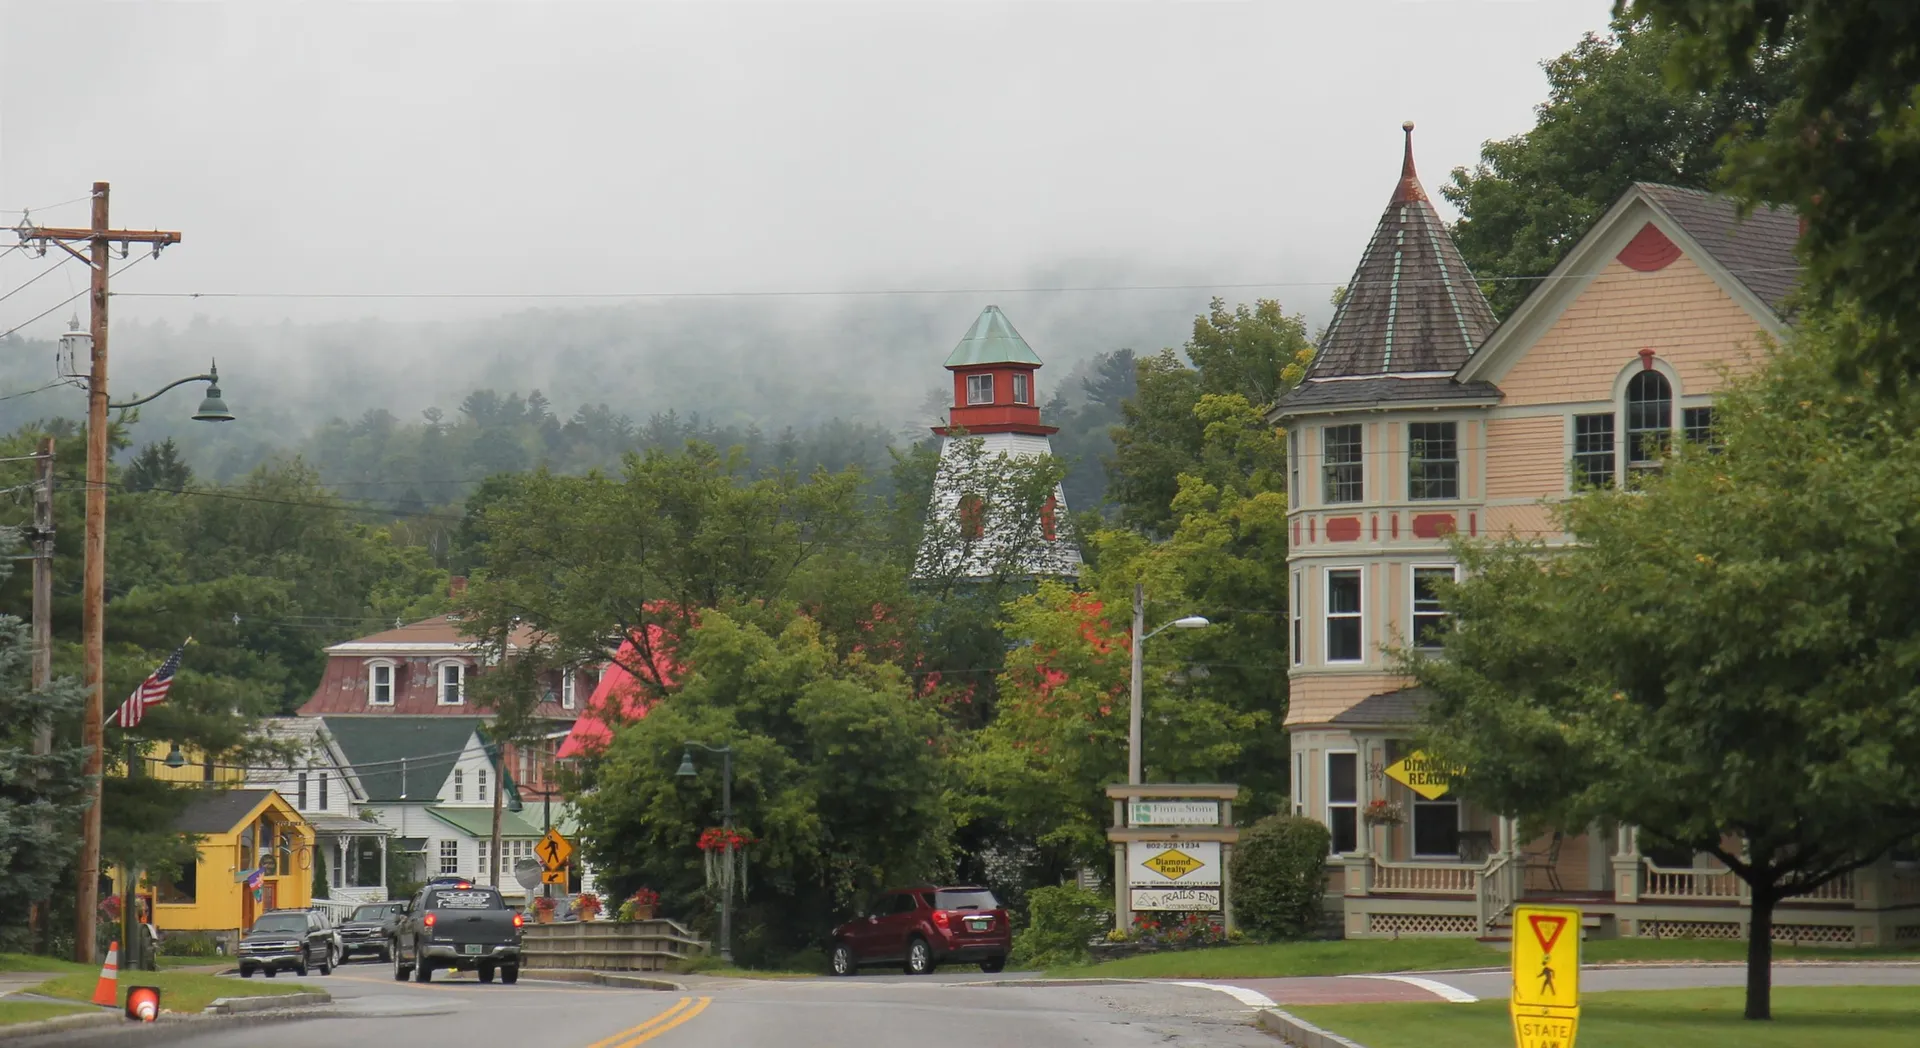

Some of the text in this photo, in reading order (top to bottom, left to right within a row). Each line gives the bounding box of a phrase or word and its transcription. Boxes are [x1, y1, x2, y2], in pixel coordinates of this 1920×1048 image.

[1403, 759, 1462, 772] DIAD
[1409, 773, 1449, 785] REAL
[1153, 804, 1177, 813] Finn
[1185, 804, 1215, 813] Stone
[1155, 858, 1191, 866] Diamond
[1160, 865, 1187, 874] Realty
[1161, 889, 1219, 906] TRAILS END
[1523, 1023, 1568, 1039] STATE
[1530, 1039, 1561, 1048] LAW
